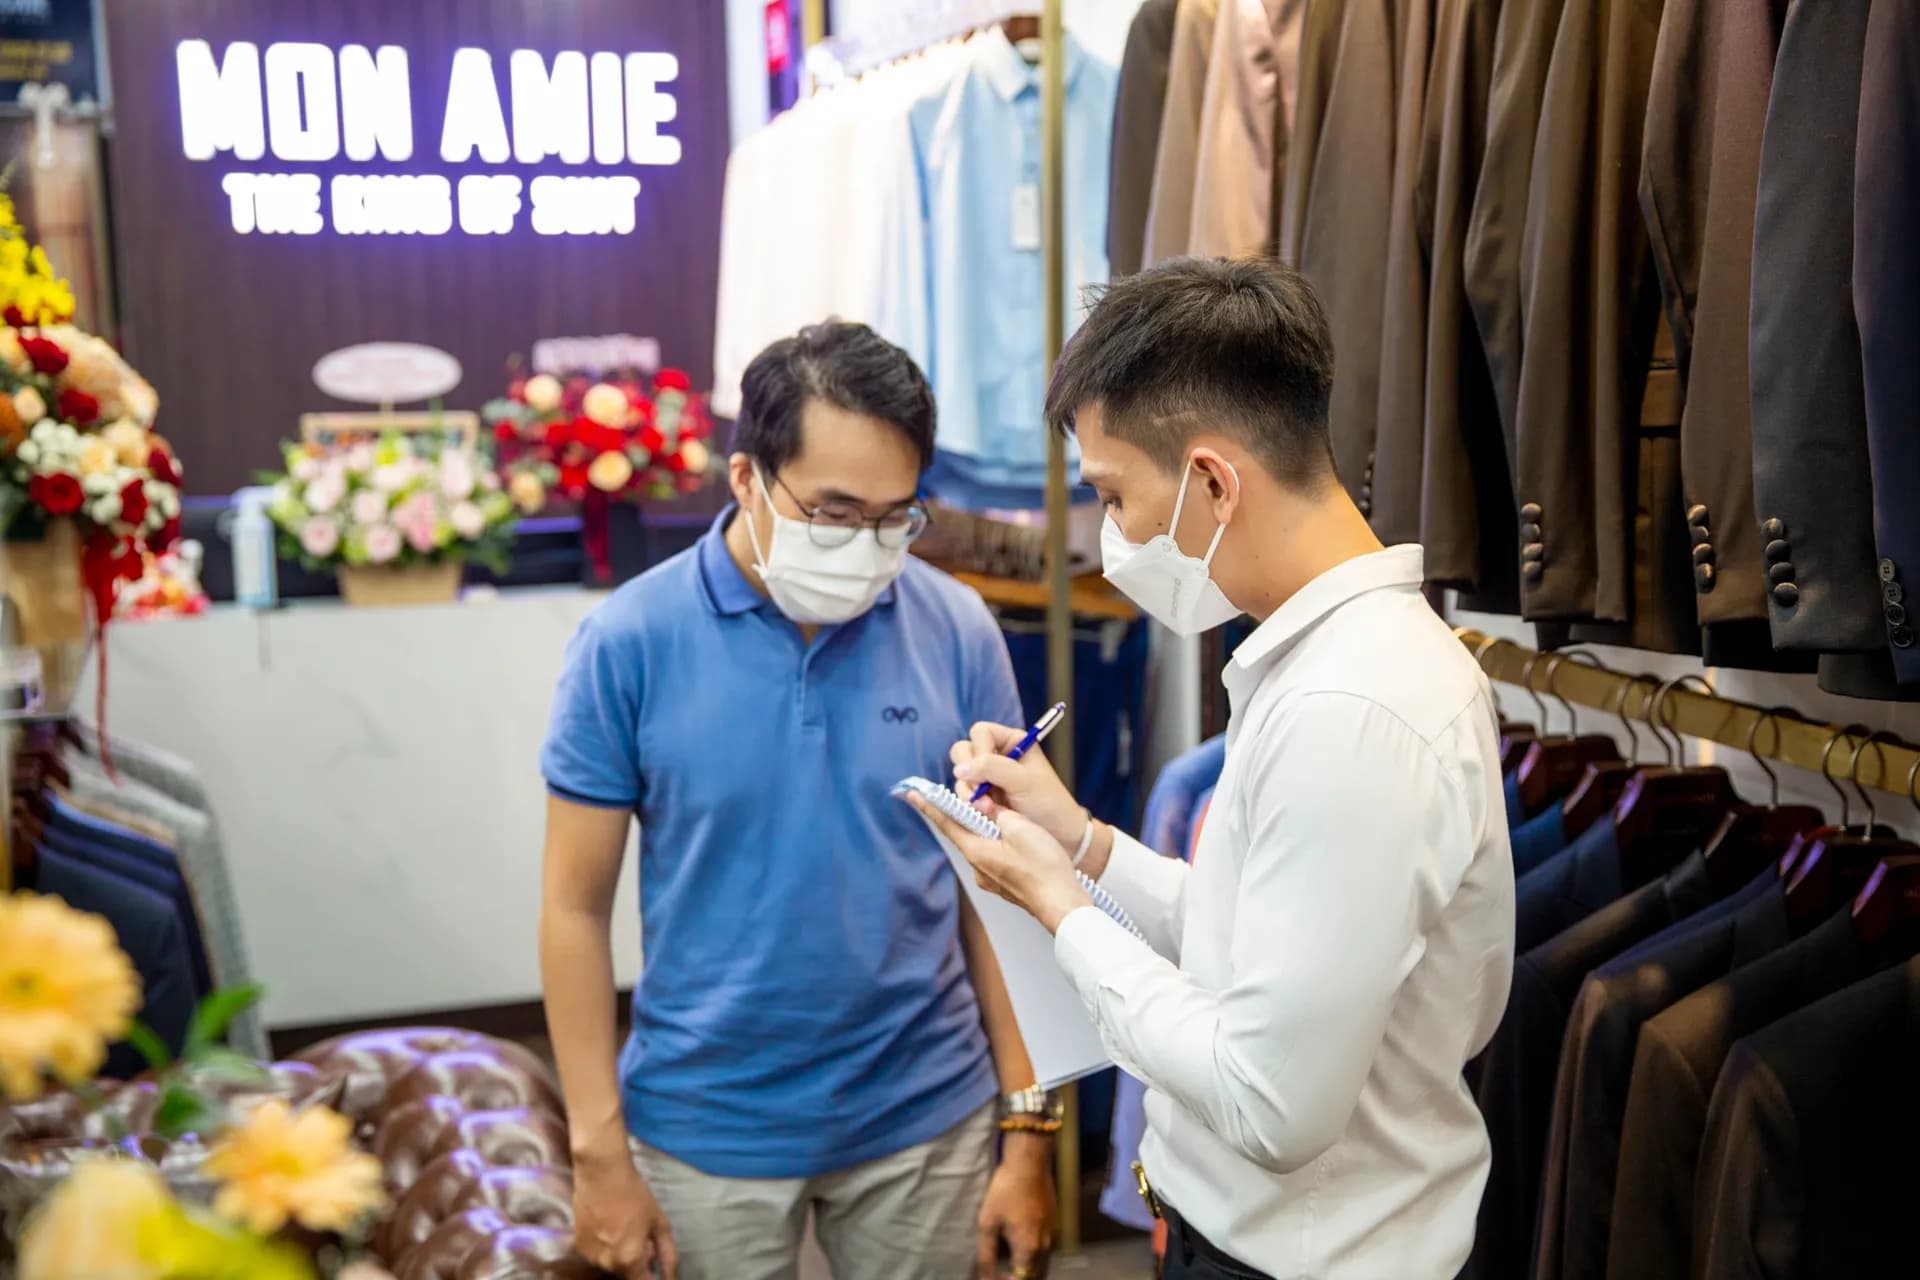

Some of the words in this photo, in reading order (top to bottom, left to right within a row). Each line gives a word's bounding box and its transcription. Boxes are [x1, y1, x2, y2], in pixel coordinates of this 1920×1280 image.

[176, 39, 413, 161] MON
[440, 47, 682, 165] AMIE
[222, 172, 324, 235] THE
[458, 175, 522, 235] OF
